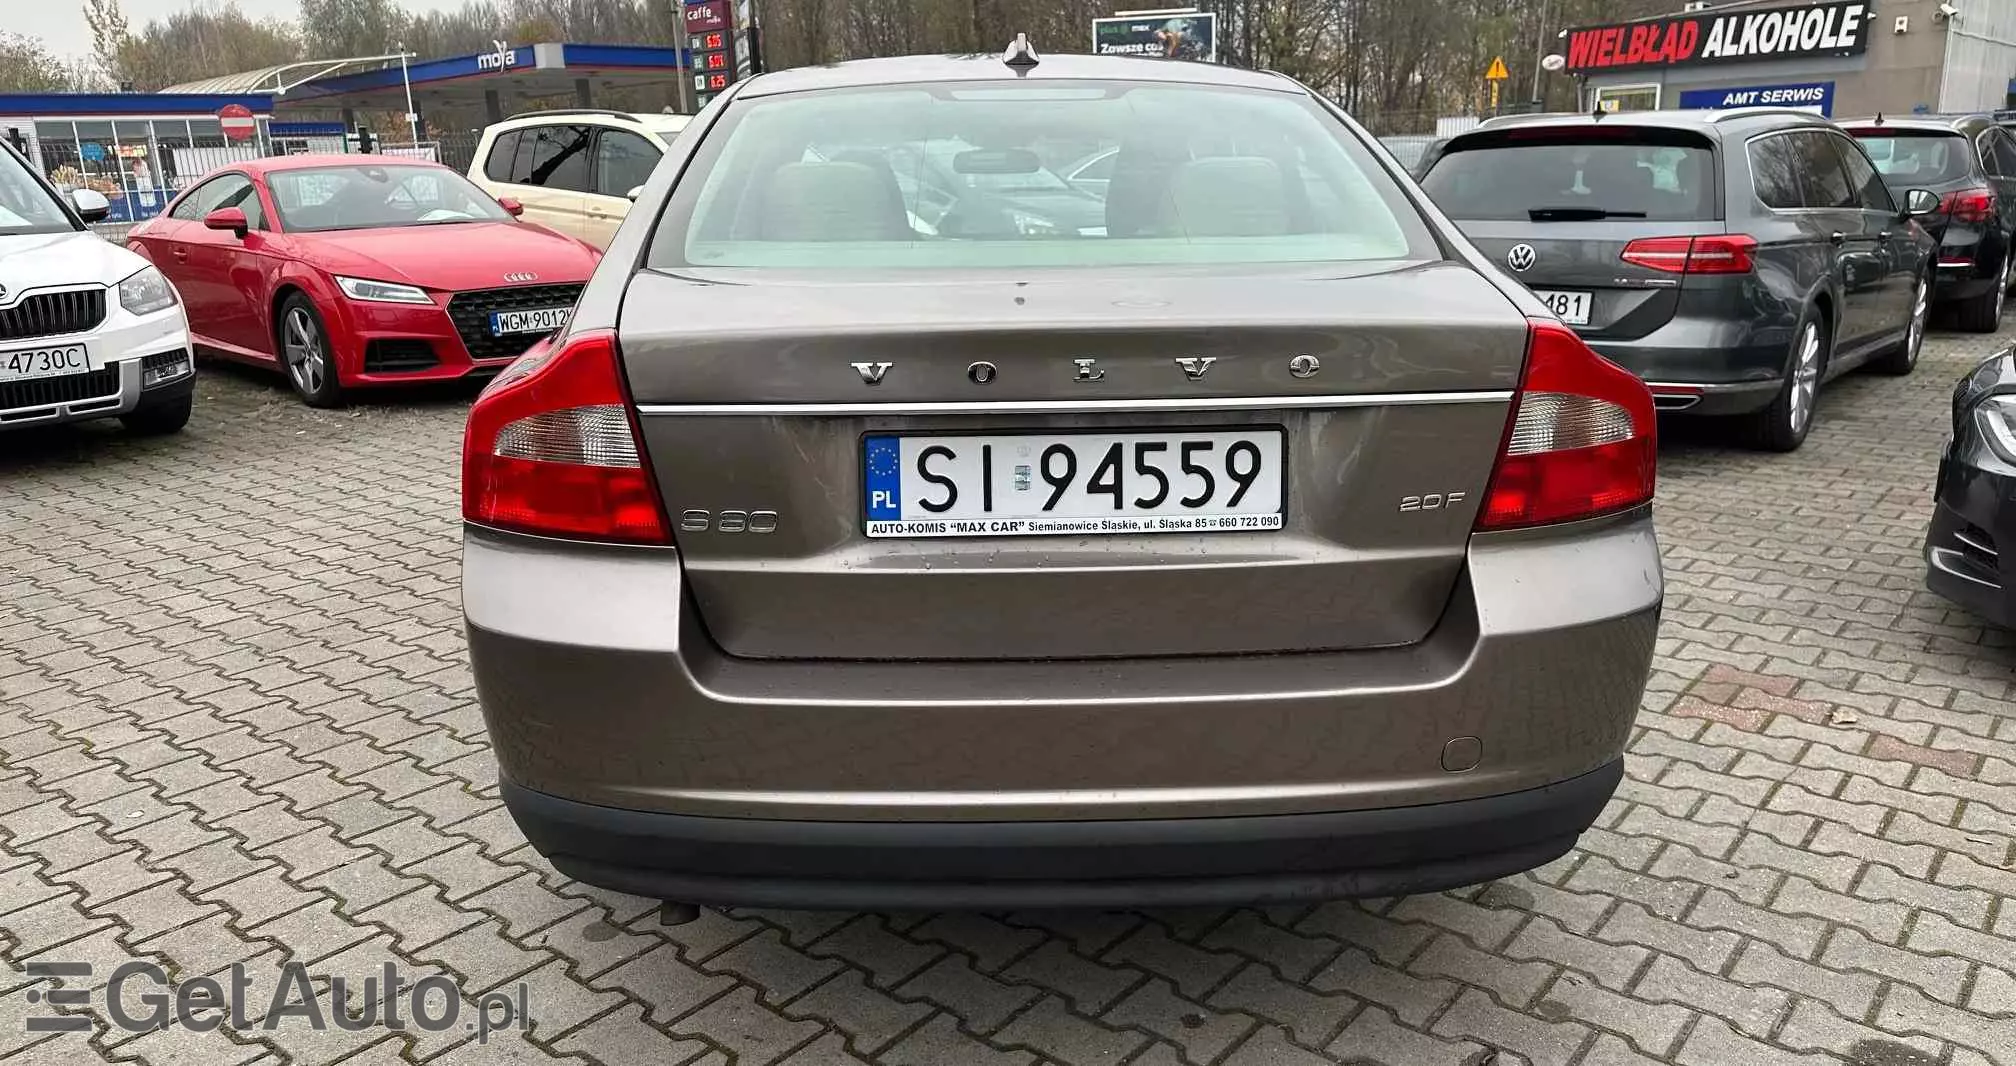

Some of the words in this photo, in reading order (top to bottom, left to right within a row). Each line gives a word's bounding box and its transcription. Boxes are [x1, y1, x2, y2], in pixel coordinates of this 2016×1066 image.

[687, 6, 712, 20] caffe
[1568, 20, 1696, 69] WIELBŁĄD
[1701, 5, 1863, 58] ALKOHOLE
[477, 39, 516, 73] moya
[1722, 92, 1760, 106] AMT
[1760, 87, 1825, 103] SERWIS
[499, 313, 530, 331] WGM
[8, 348, 81, 373] 4730C
[851, 355, 1321, 386] VOLVO
[917, 444, 993, 513] SI
[1040, 440, 1262, 512] 94559
[872, 490, 897, 509] PL
[871, 522, 946, 534] AUTO-KOMIS
[1028, 520, 1099, 531] Siemianowice
[1144, 519, 1156, 529] ul.
[1195, 518, 1207, 528] 85
[1219, 517, 1237, 528] 660
[1240, 517, 1258, 527] 722
[1260, 516, 1279, 526] 090
